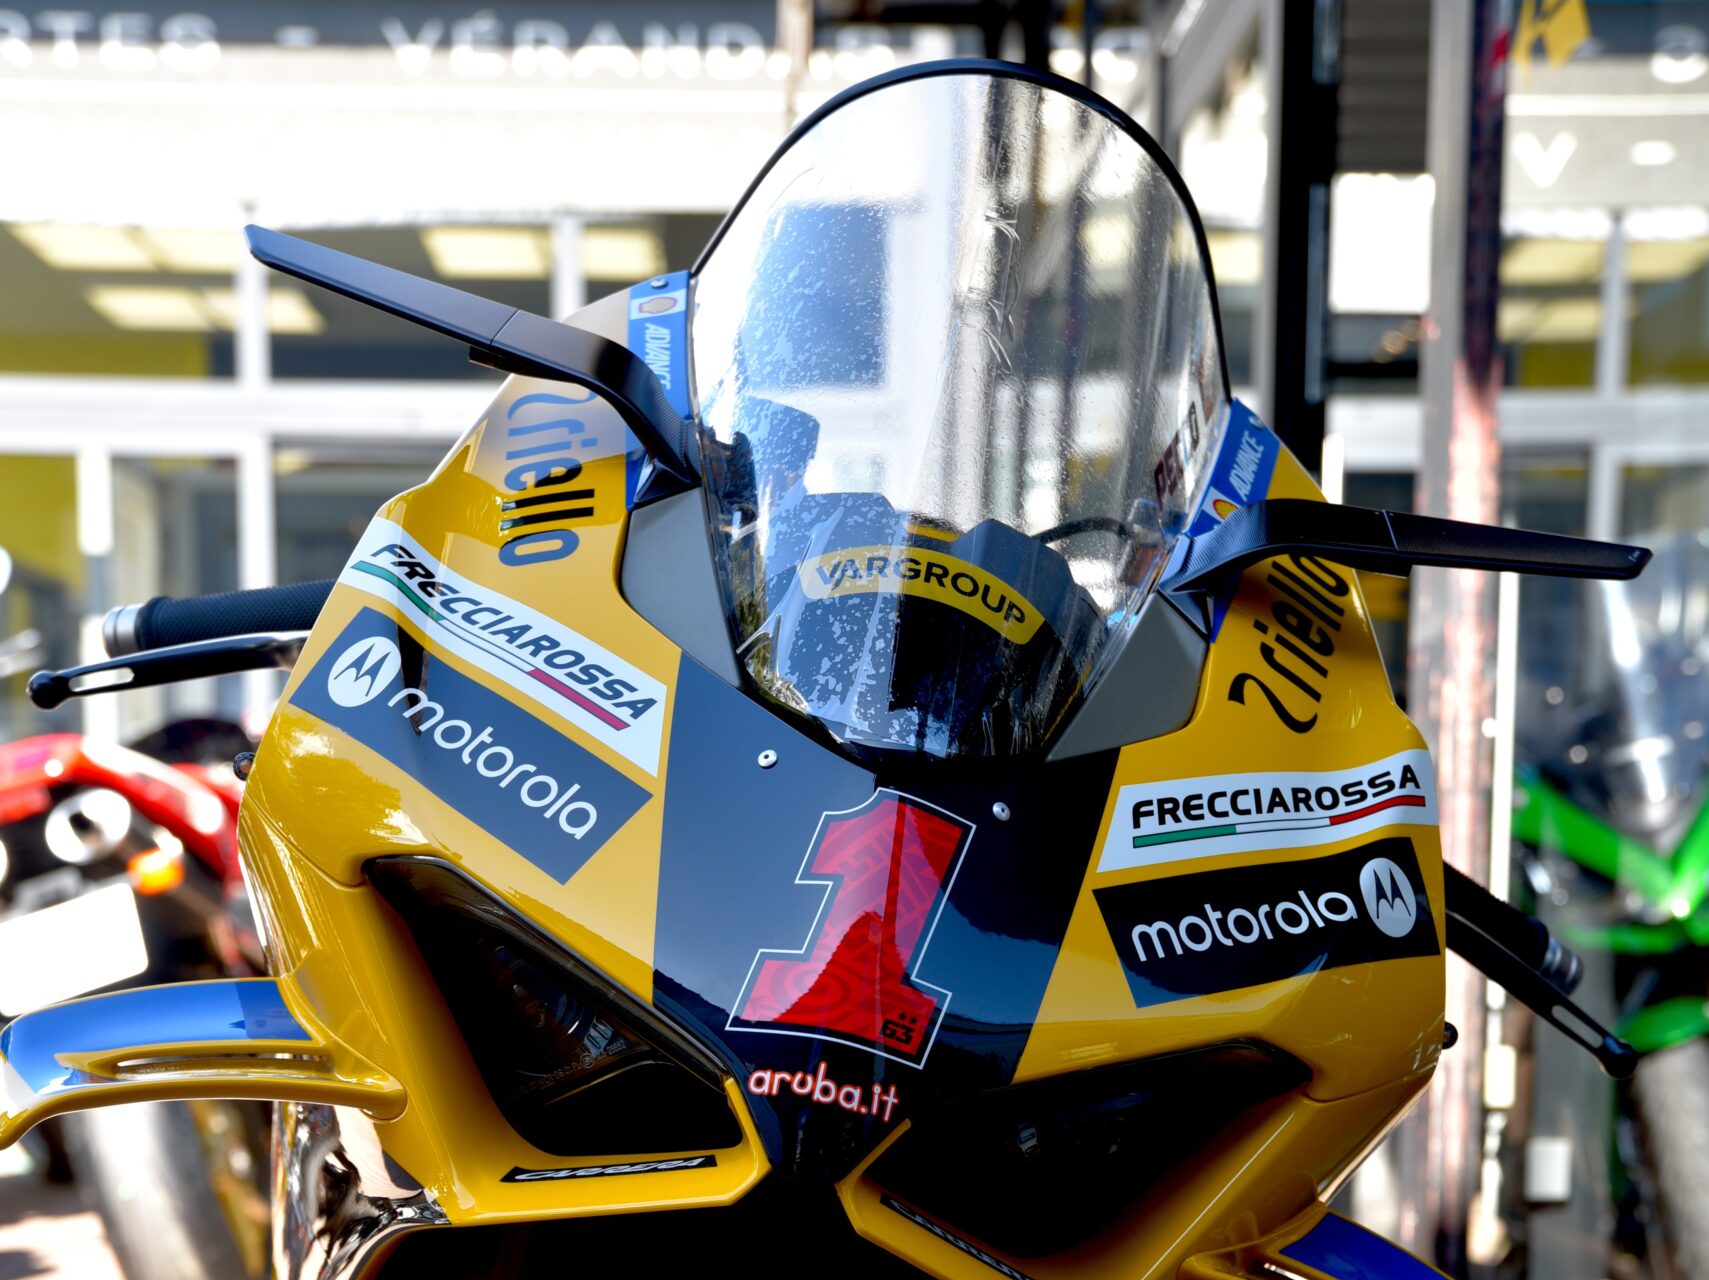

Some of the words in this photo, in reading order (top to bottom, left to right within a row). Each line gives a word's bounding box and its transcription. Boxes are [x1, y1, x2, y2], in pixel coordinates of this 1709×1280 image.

[645, 322, 671, 390] ADVANC
[1229, 430, 1264, 502] ADVANCE
[371, 543, 658, 723] FRECCIAROSSA
[387, 686, 597, 841] motorola
[1132, 764, 1421, 829] FRECCIAROSSA
[737, 796, 966, 1061] 1
[1131, 889, 1358, 962] motorola
[881, 1018, 915, 1045] 63
[748, 1061, 899, 1123] aruba.it
